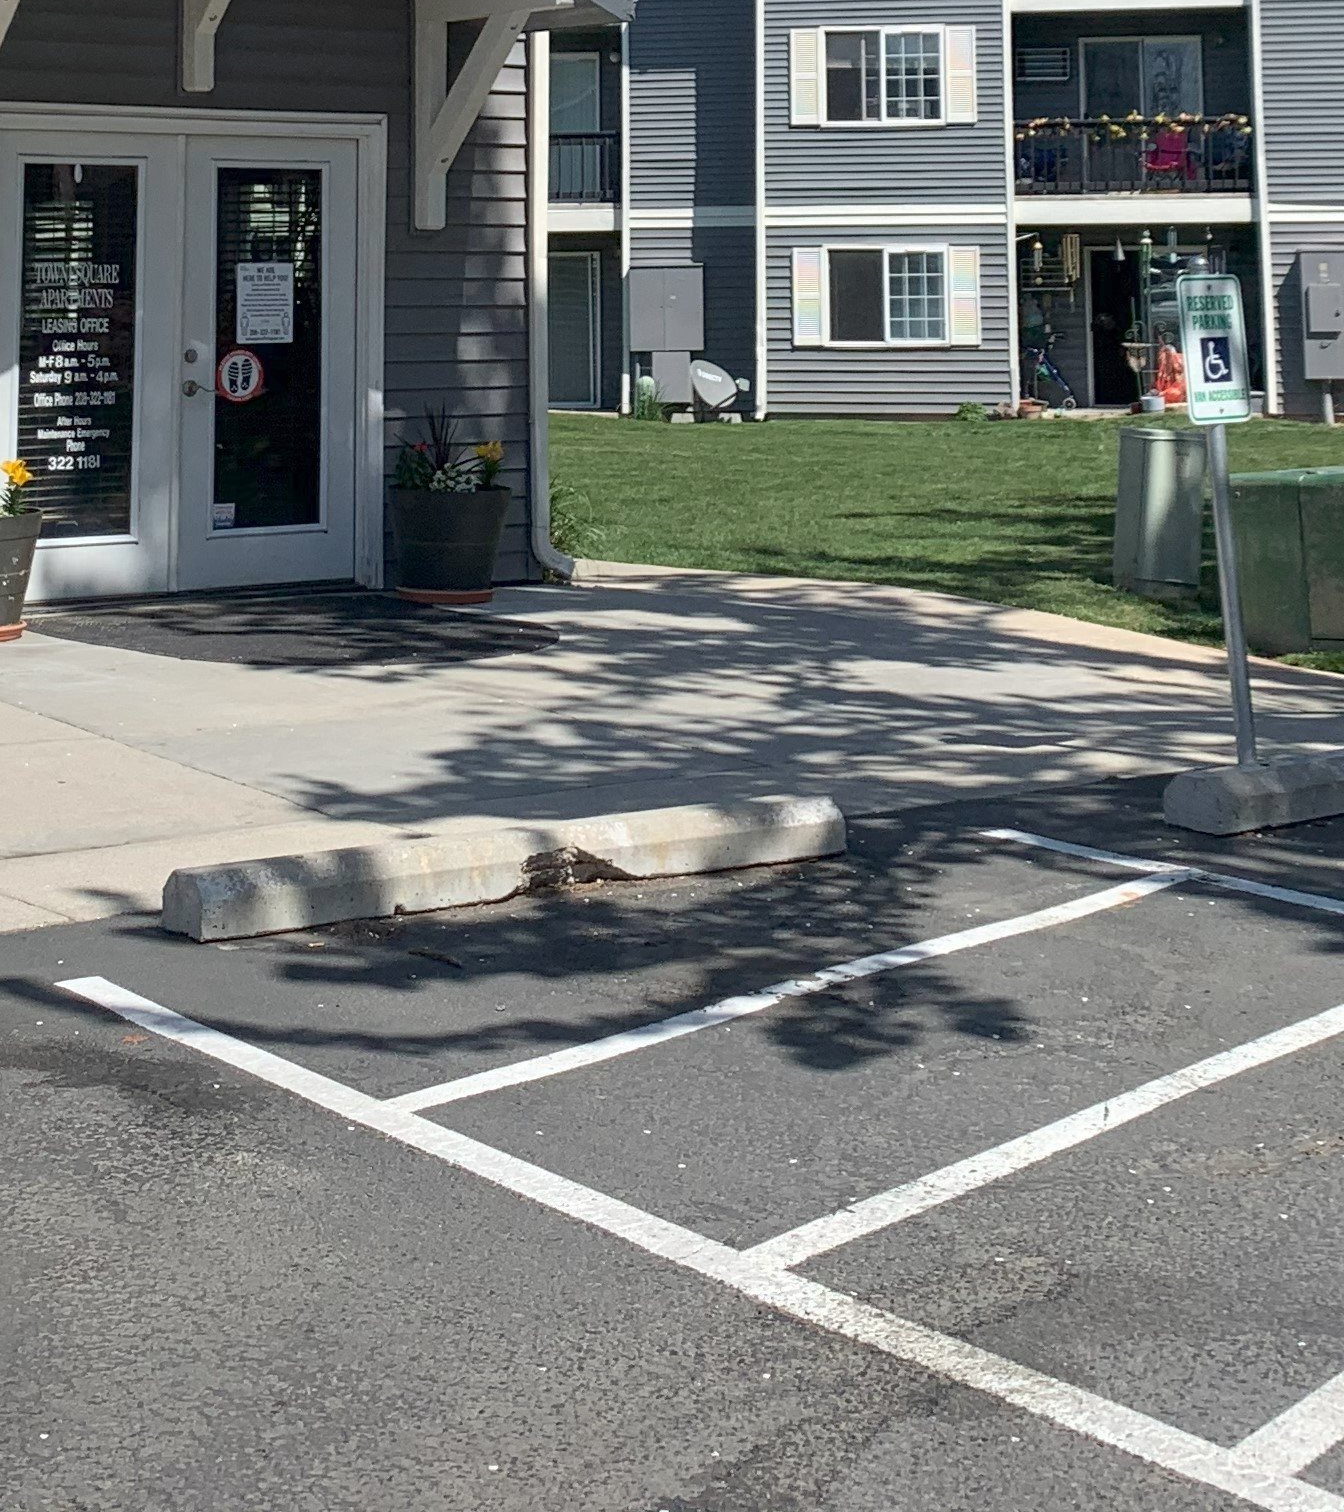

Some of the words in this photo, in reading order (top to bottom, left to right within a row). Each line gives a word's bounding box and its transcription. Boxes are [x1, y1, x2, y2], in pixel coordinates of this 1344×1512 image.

[76, 261, 119, 286] SQUARE
[1186, 295, 1234, 311] RESERVED
[42, 318, 77, 334] LEASING
[80, 317, 109, 333] OFFICE
[1192, 314, 1233, 330] PARKING
[52, 339, 75, 352] Office
[77, 339, 99, 351] Hours
[30, 370, 62, 385] Saturday
[34, 392, 53, 407] Office
[54, 392, 73, 406] Phone
[57, 416, 72, 426] After
[74, 416, 91, 426] Hours
[37, 429, 75, 439] Maintenance
[77, 428, 110, 439] Emergency
[66, 439, 85, 452] Phone
[48, 455, 74, 470] 322
[76, 454, 100, 469] 1181
